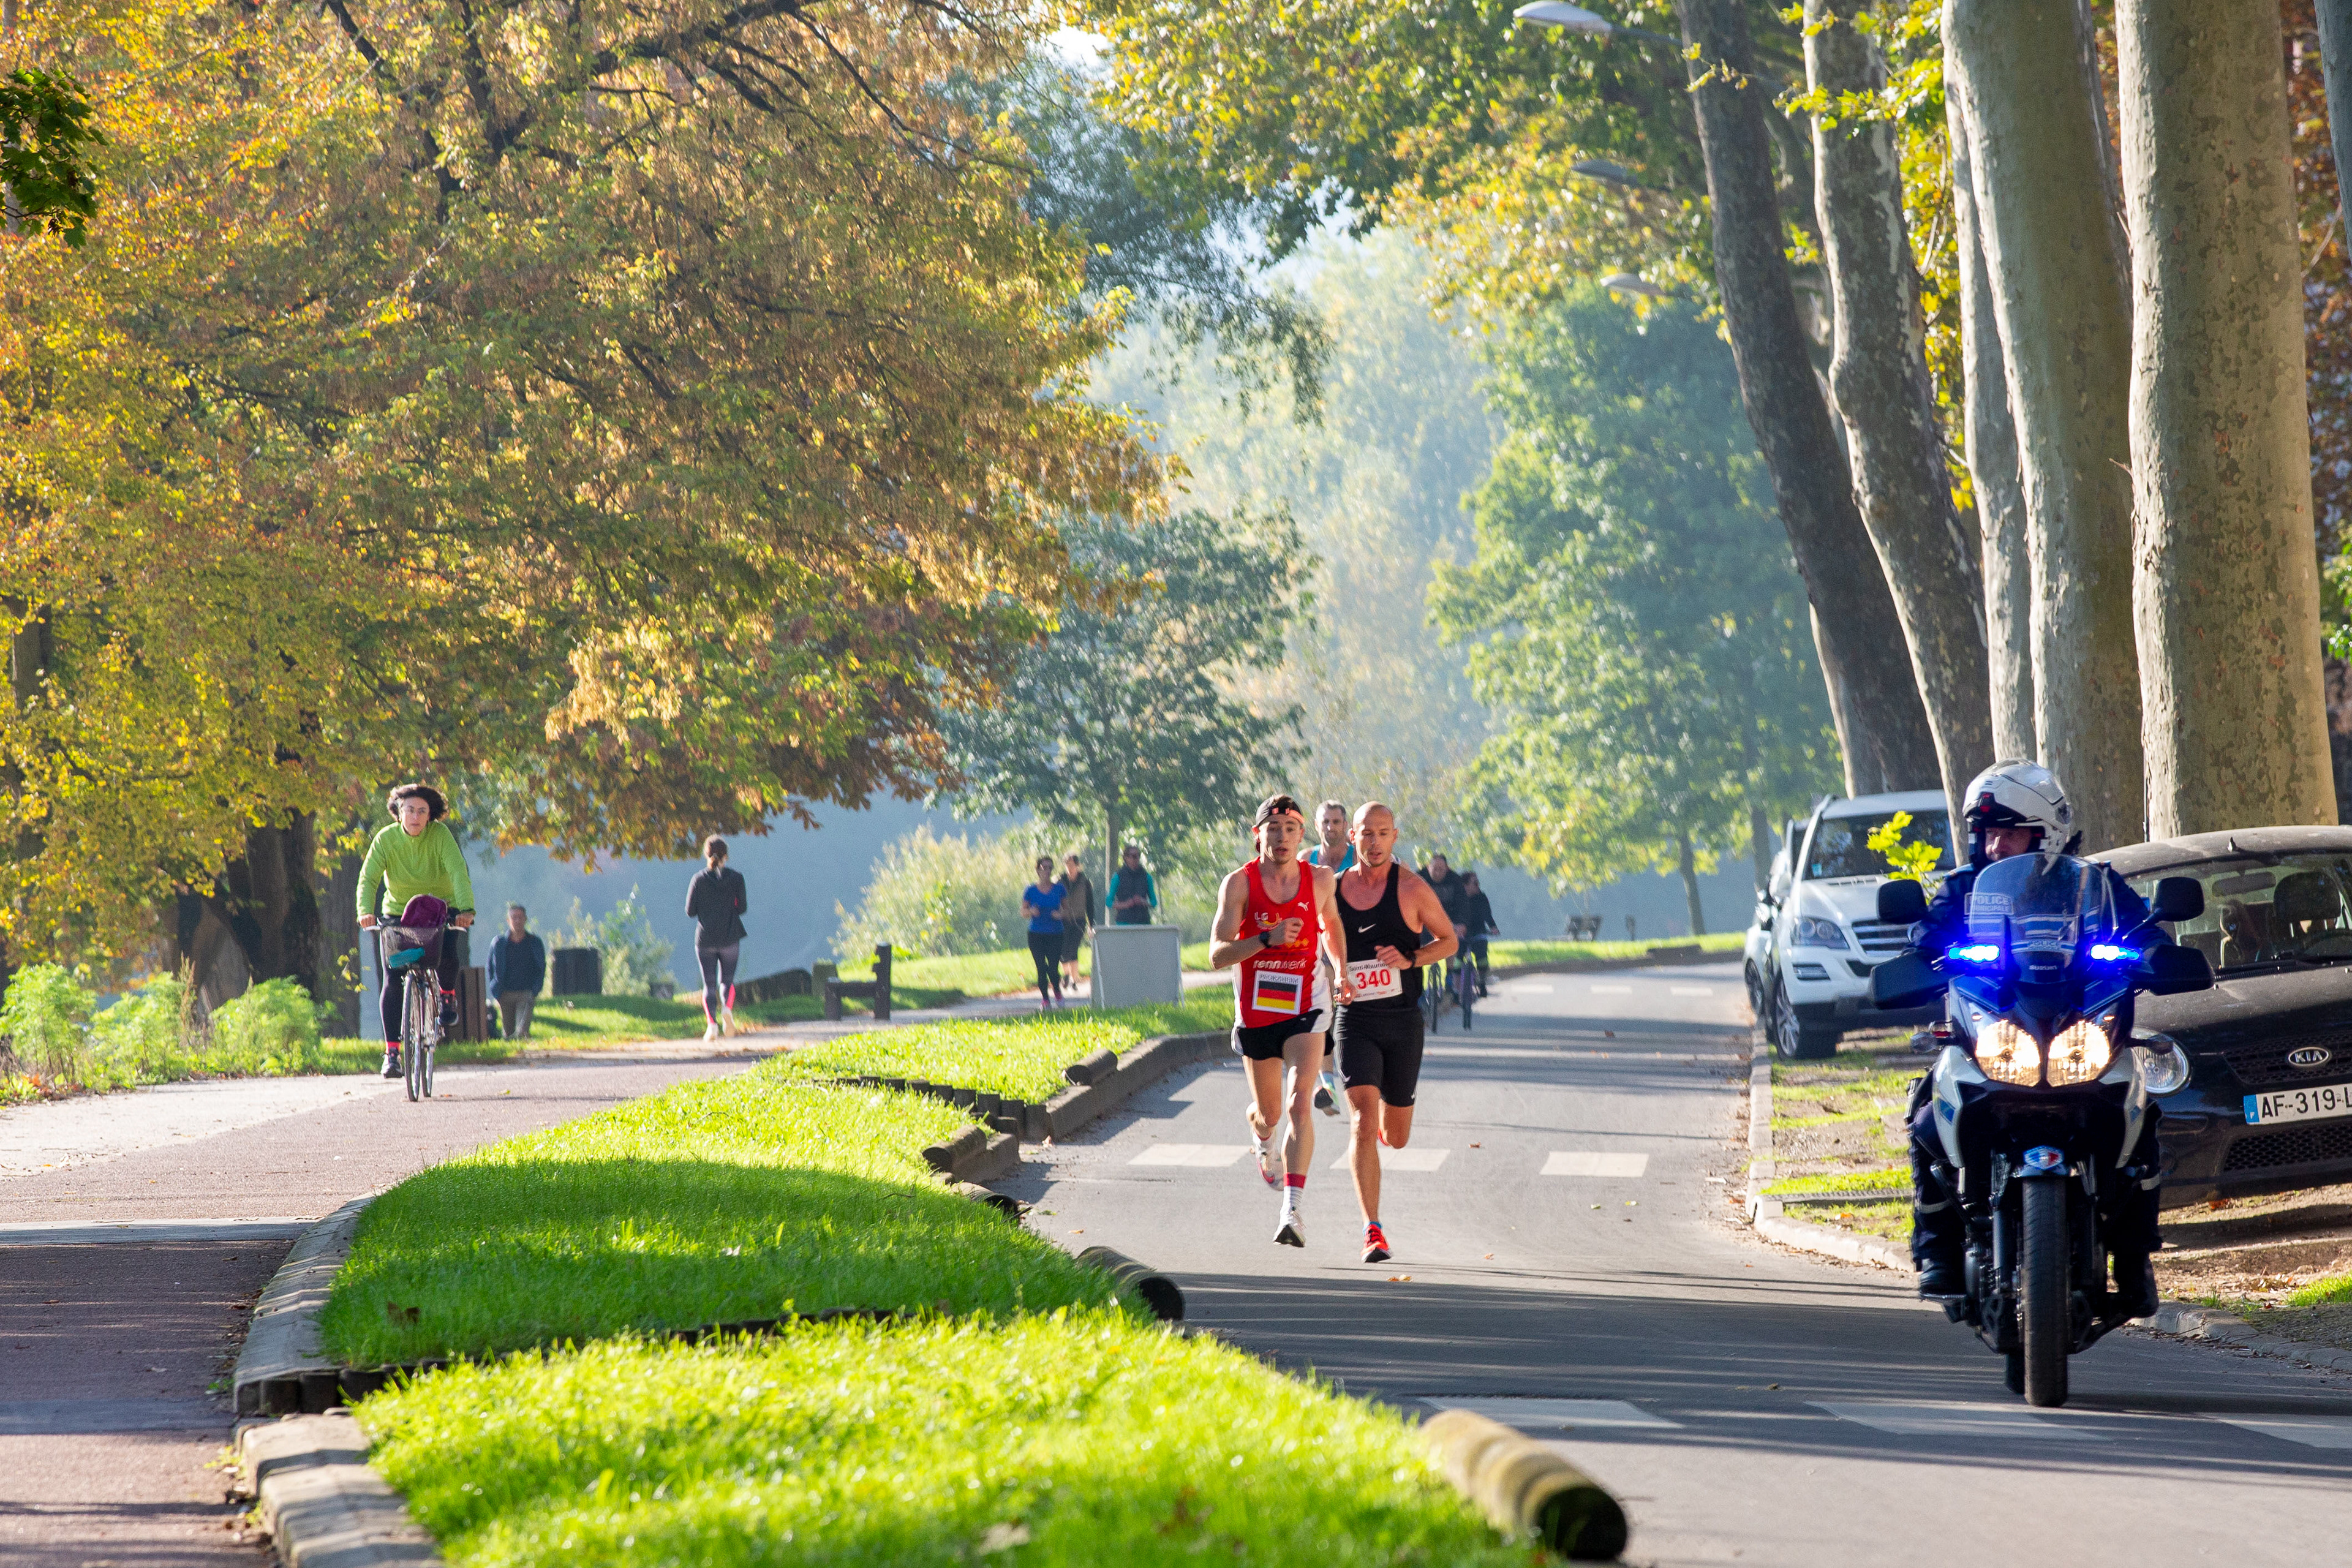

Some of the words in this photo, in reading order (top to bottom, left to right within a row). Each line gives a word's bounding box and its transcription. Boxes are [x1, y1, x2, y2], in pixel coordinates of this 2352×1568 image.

[1969, 895, 2010, 905] POLICE
[1254, 911, 1268, 921] LG
[1253, 957, 1307, 970] rennwerk
[1355, 969, 1390, 989] 340
[2294, 1050, 2323, 1063] KIA
